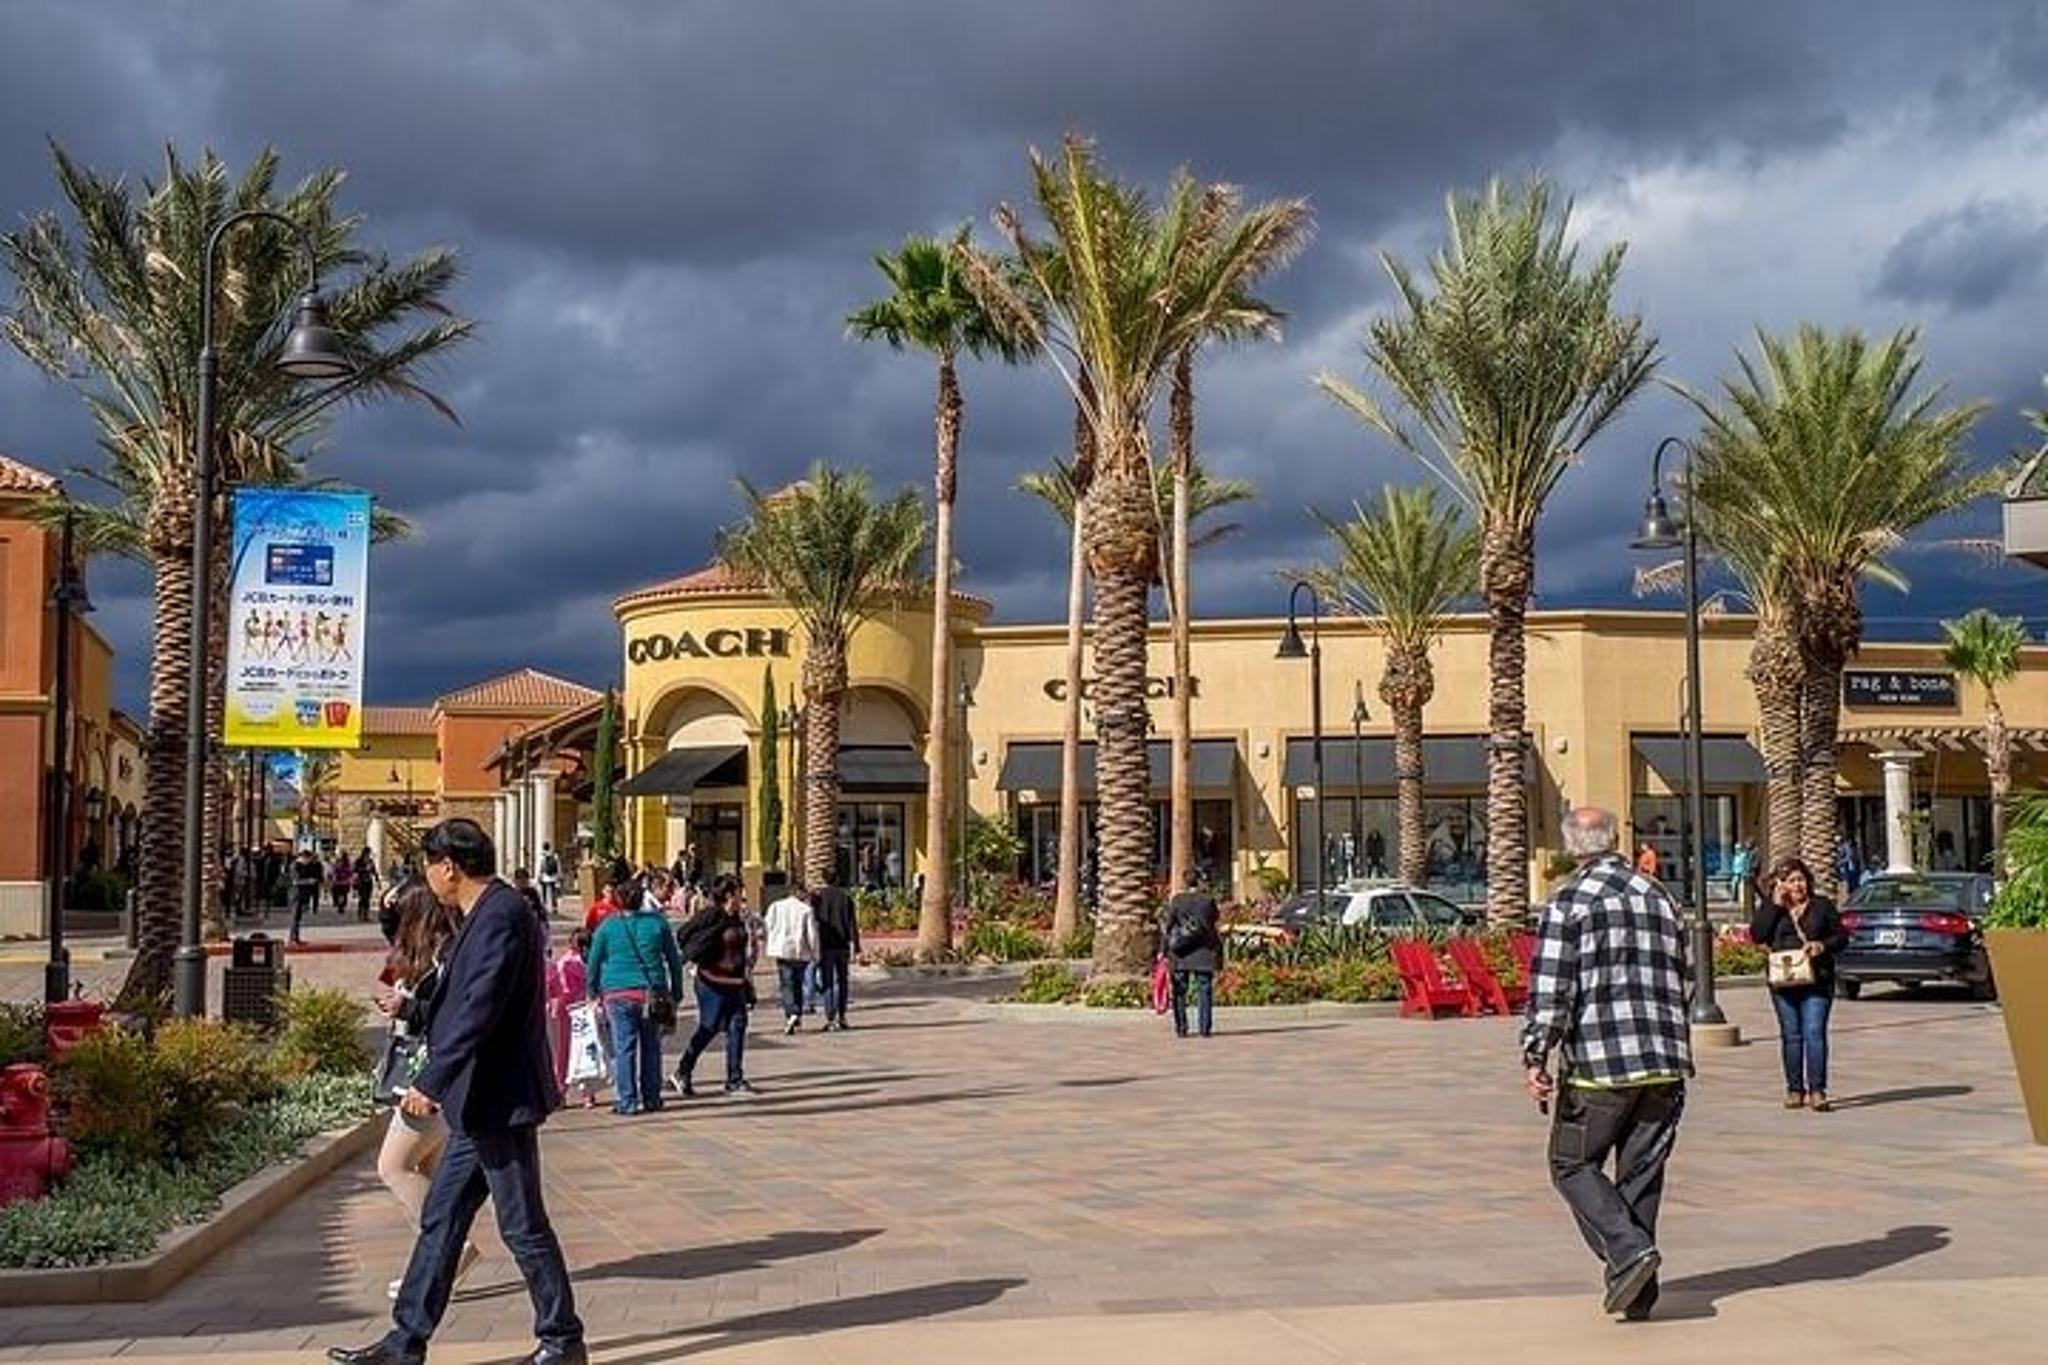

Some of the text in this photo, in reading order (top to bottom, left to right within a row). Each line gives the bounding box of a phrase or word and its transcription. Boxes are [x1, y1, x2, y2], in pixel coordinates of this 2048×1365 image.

[628, 628, 791, 665] COACH
[1043, 676, 1201, 700] COCH
[1851, 675, 1950, 692] rag & bone
